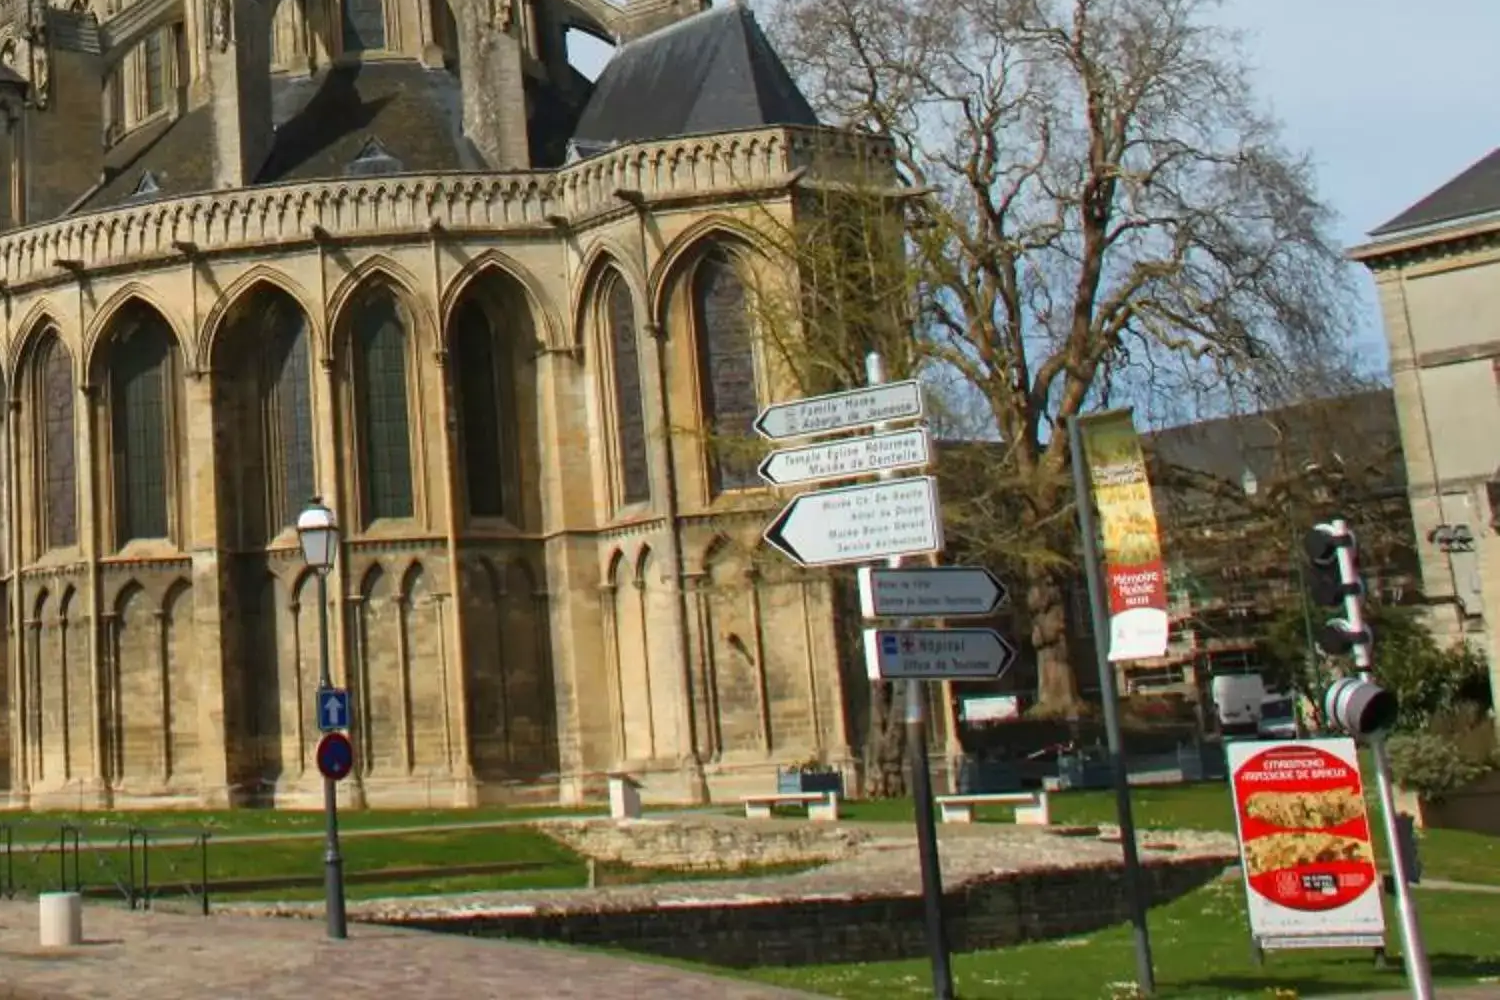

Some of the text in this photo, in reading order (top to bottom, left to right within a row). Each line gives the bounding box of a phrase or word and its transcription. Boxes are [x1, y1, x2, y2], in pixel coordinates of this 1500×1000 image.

[801, 401, 837, 416] Family
[785, 451, 820, 466] Temple
[869, 449, 917, 466] Dentelle
[919, 637, 965, 654] Hôpital
[903, 659, 931, 671] Office
